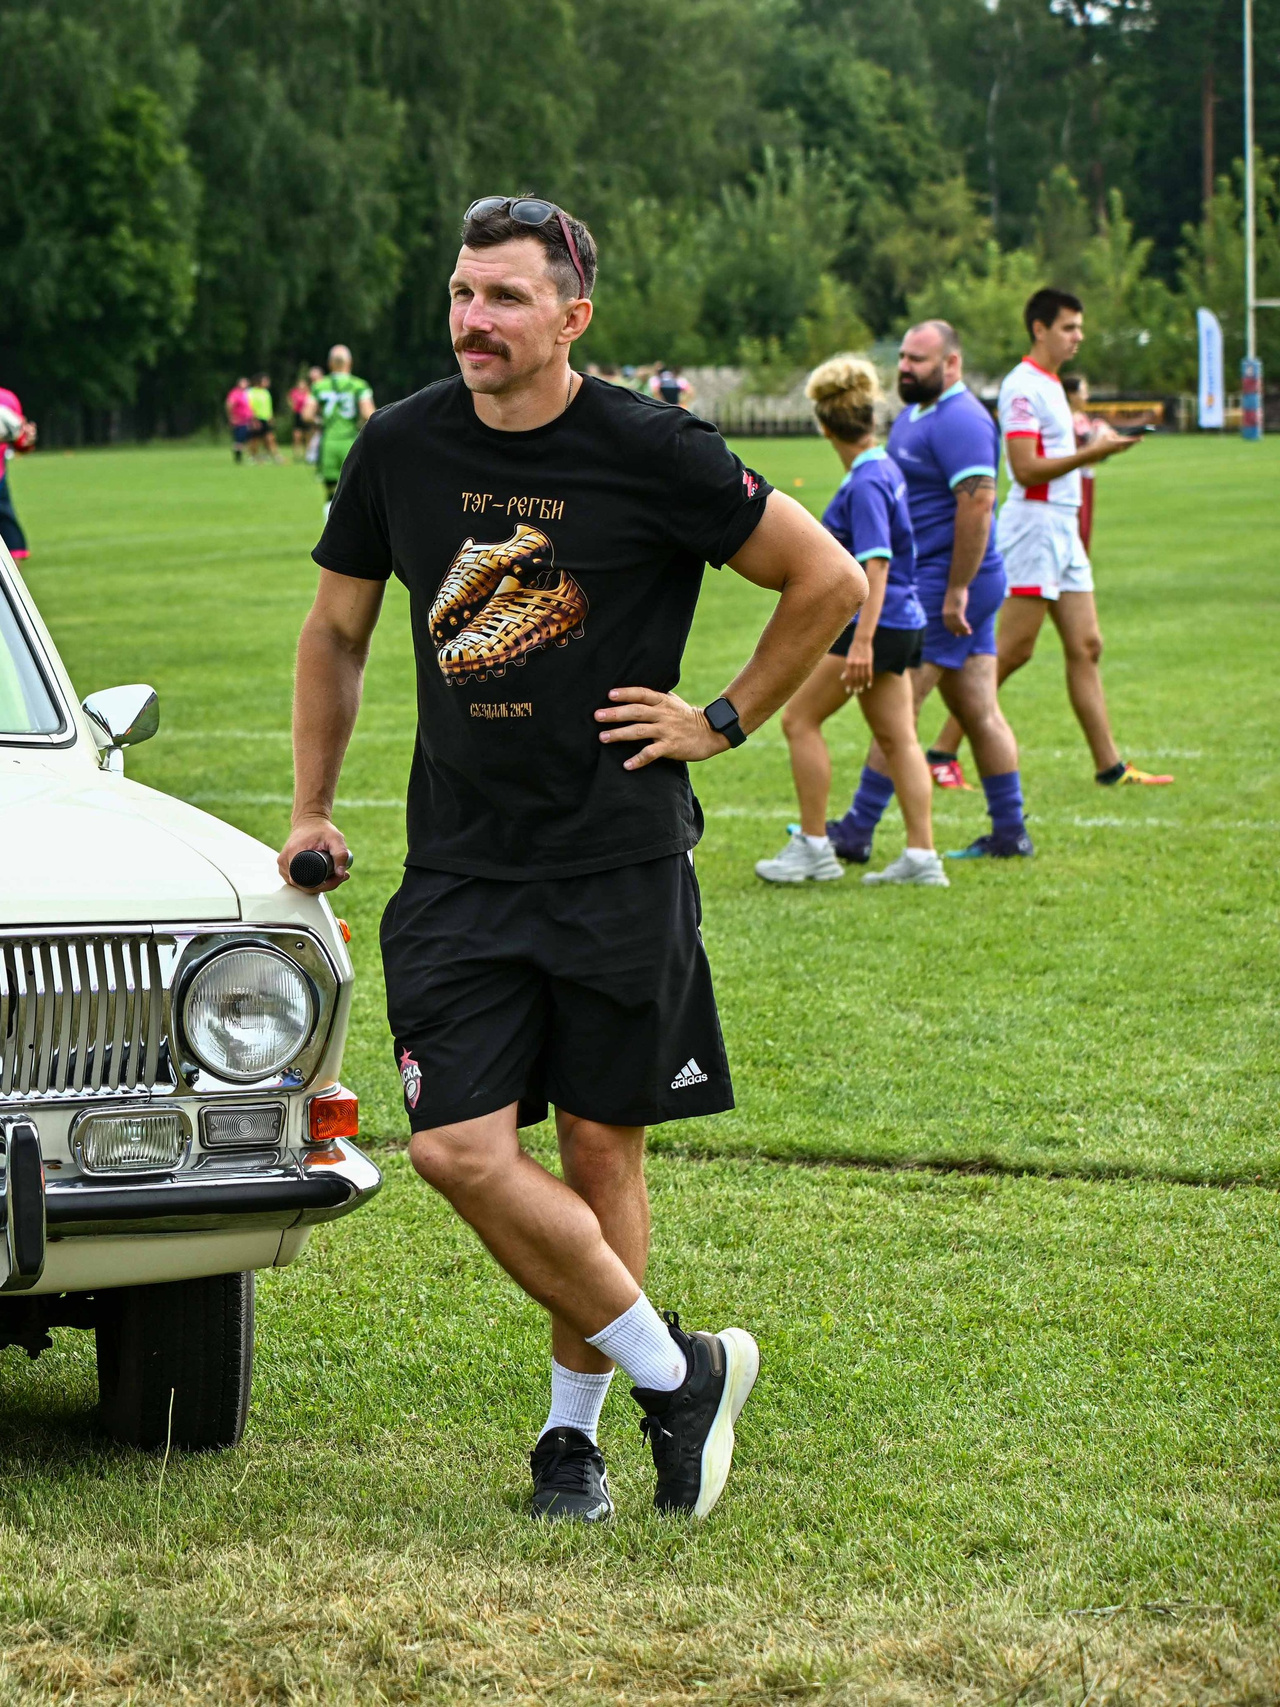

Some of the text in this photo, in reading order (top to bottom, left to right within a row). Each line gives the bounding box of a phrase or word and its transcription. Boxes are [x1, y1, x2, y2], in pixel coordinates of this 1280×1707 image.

[461, 491, 565, 520] ТЭГ-РЕГБИ
[510, 702, 533, 717] 2024
[670, 1073, 708, 1090] adidas
